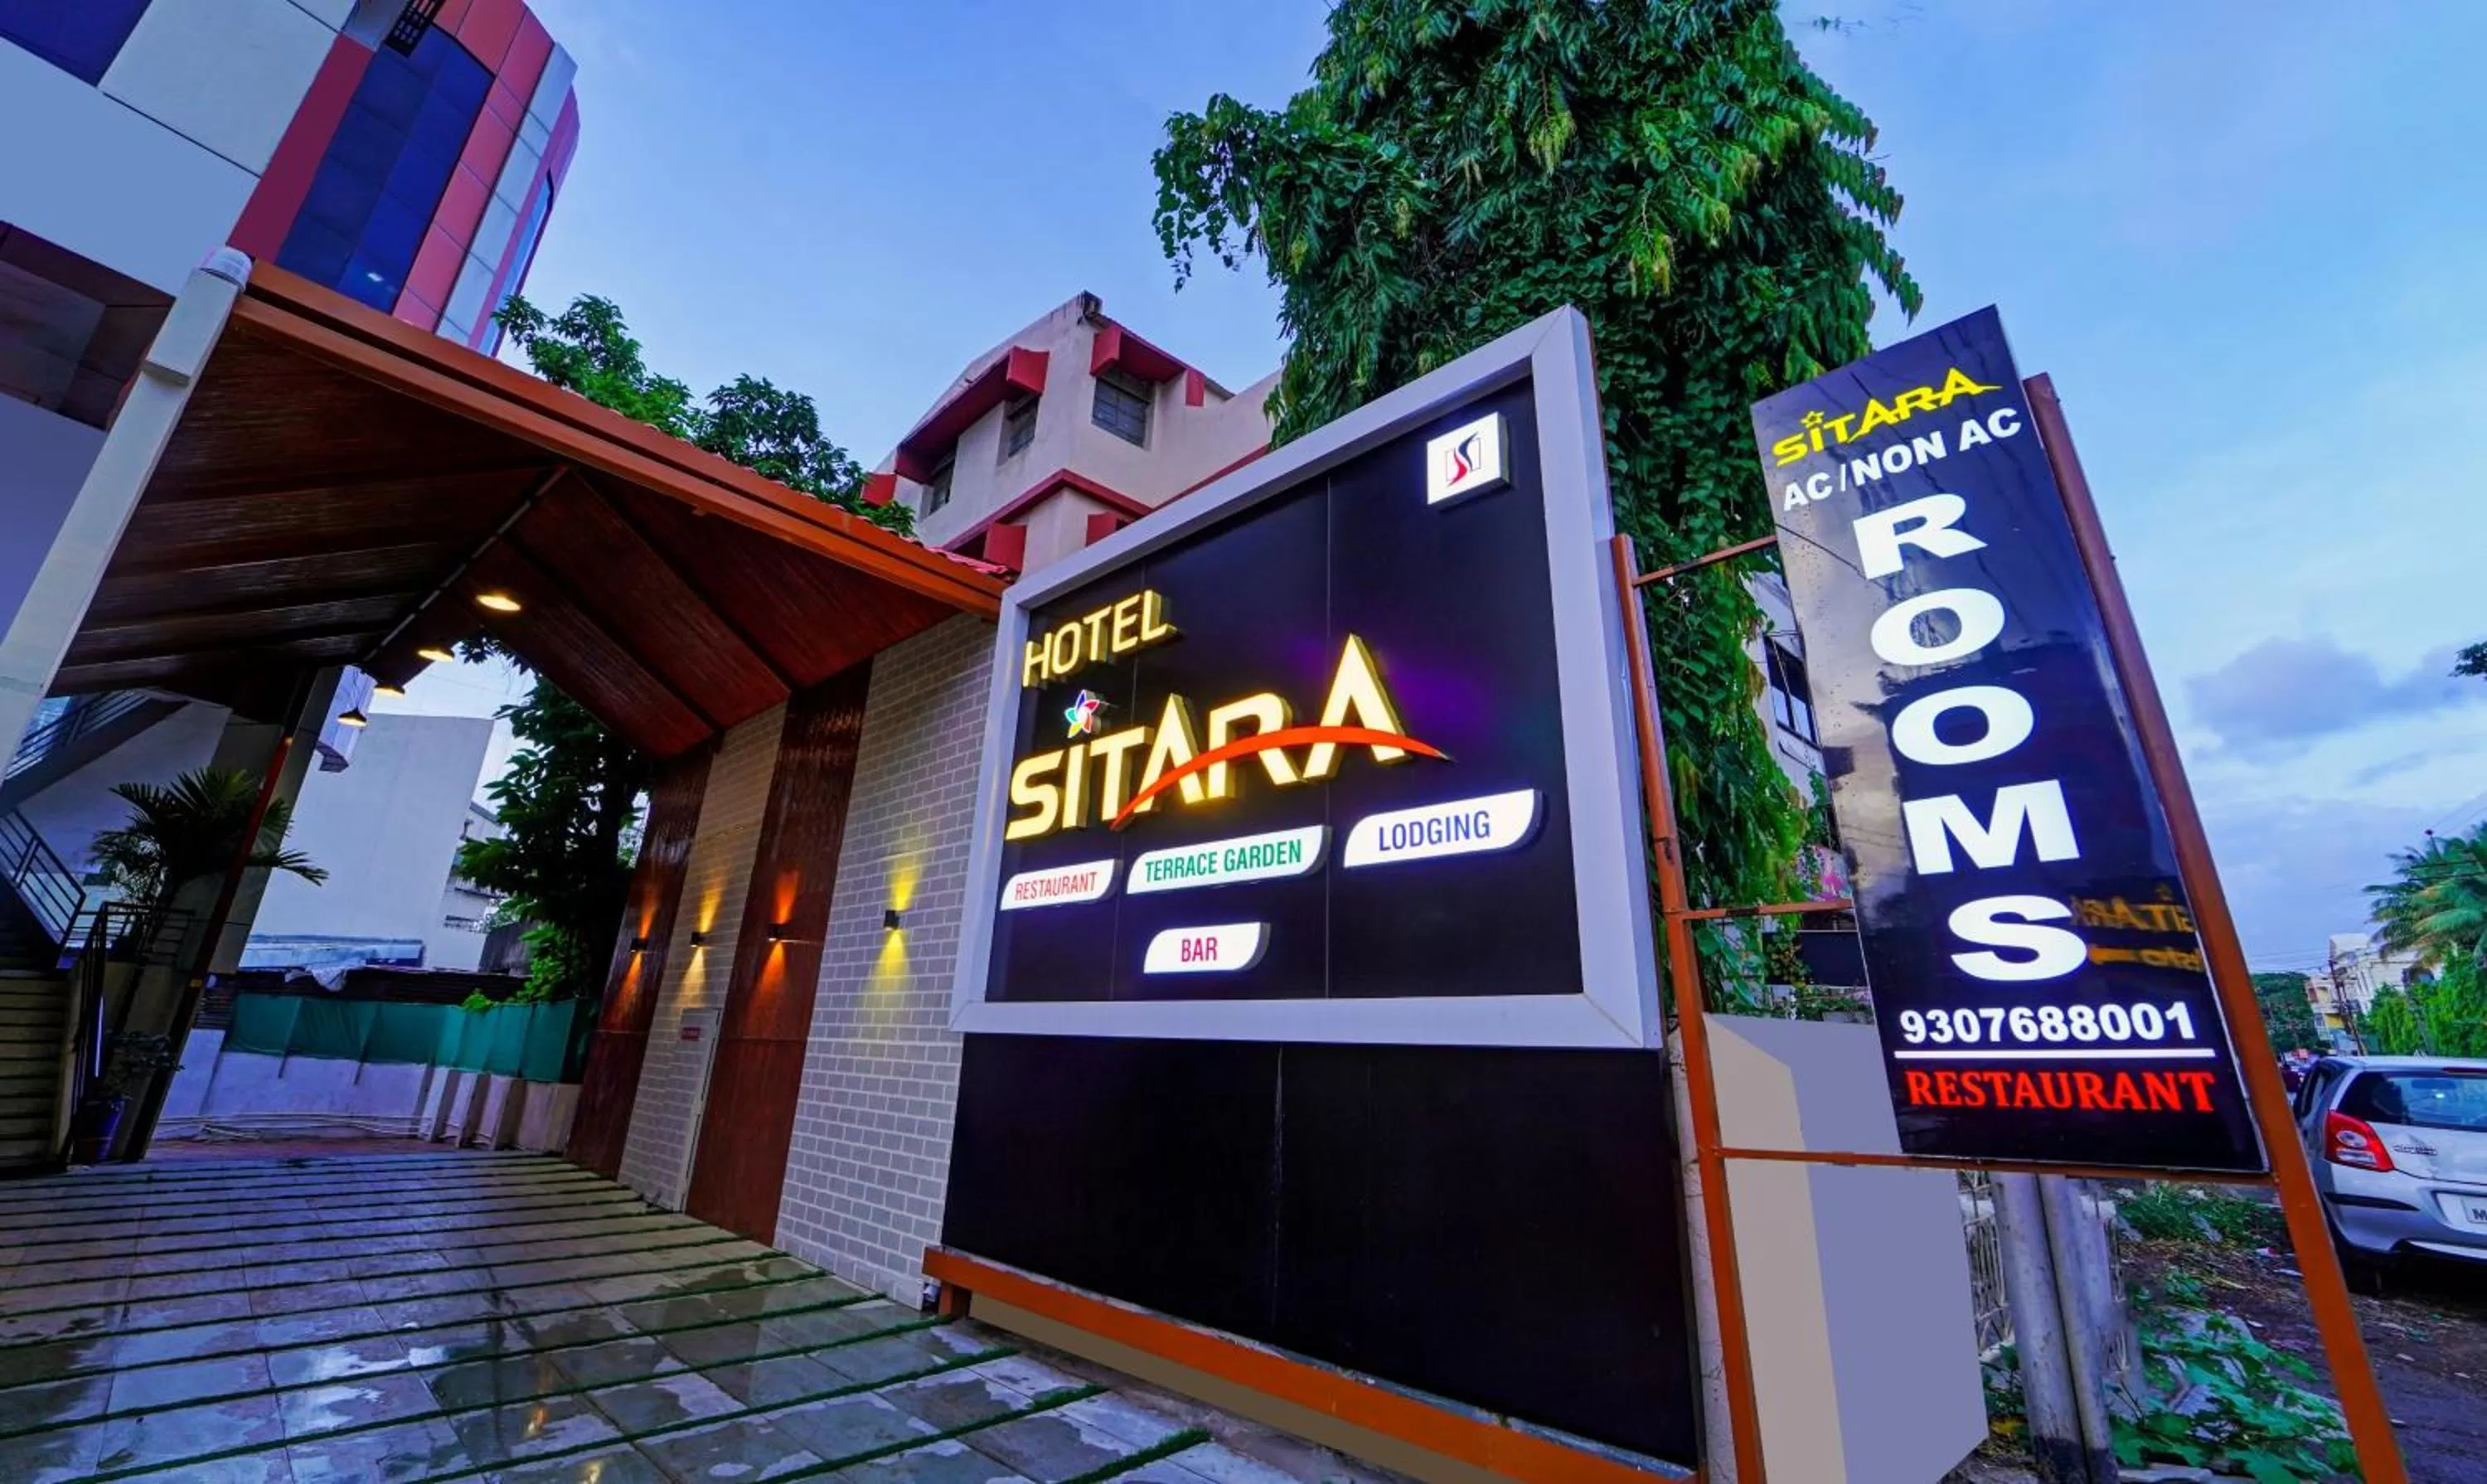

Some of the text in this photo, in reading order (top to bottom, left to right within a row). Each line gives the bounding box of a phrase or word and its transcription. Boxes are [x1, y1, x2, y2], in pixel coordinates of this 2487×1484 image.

[1772, 367, 2004, 468] SITARA
[1959, 407, 2021, 451] AC
[1023, 589, 1173, 687] HOTEL
[1005, 633, 1413, 841] SITARA
[1853, 493, 2087, 982] ROOMS
[1378, 810, 1491, 851] LODGING
[1146, 838, 1302, 883] TERRACE GARDEN
[1014, 871, 1098, 901] RESTAURANT
[1180, 936, 1219, 963] BAR
[1900, 1001, 2196, 1045] 9307688001
[1905, 1069, 2216, 1113] RESTAURANT
